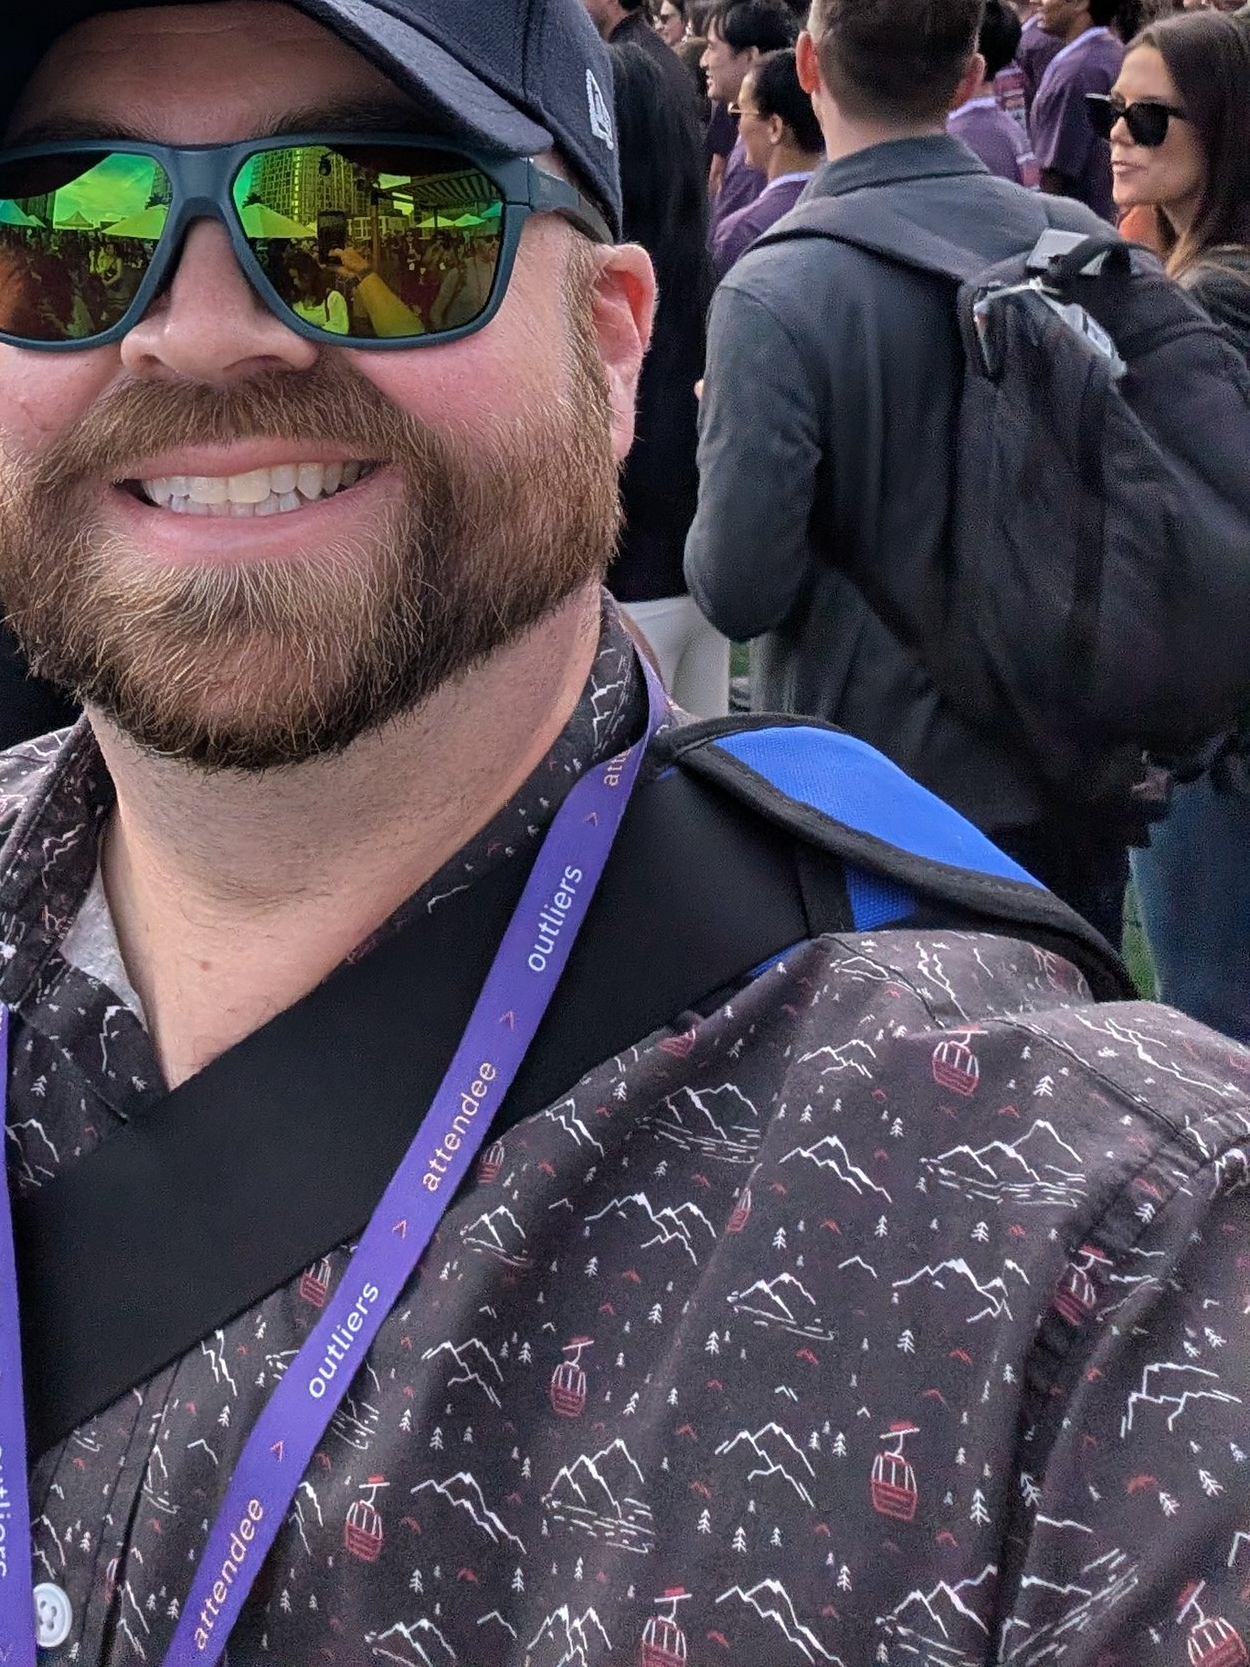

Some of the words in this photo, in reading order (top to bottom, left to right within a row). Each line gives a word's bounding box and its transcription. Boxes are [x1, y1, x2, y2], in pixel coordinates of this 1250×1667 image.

[194, 1498, 264, 1652] attendee
[308, 1282, 379, 1399] outliers
[421, 1061, 497, 1192] attendee
[527, 865, 583, 972] outliers
